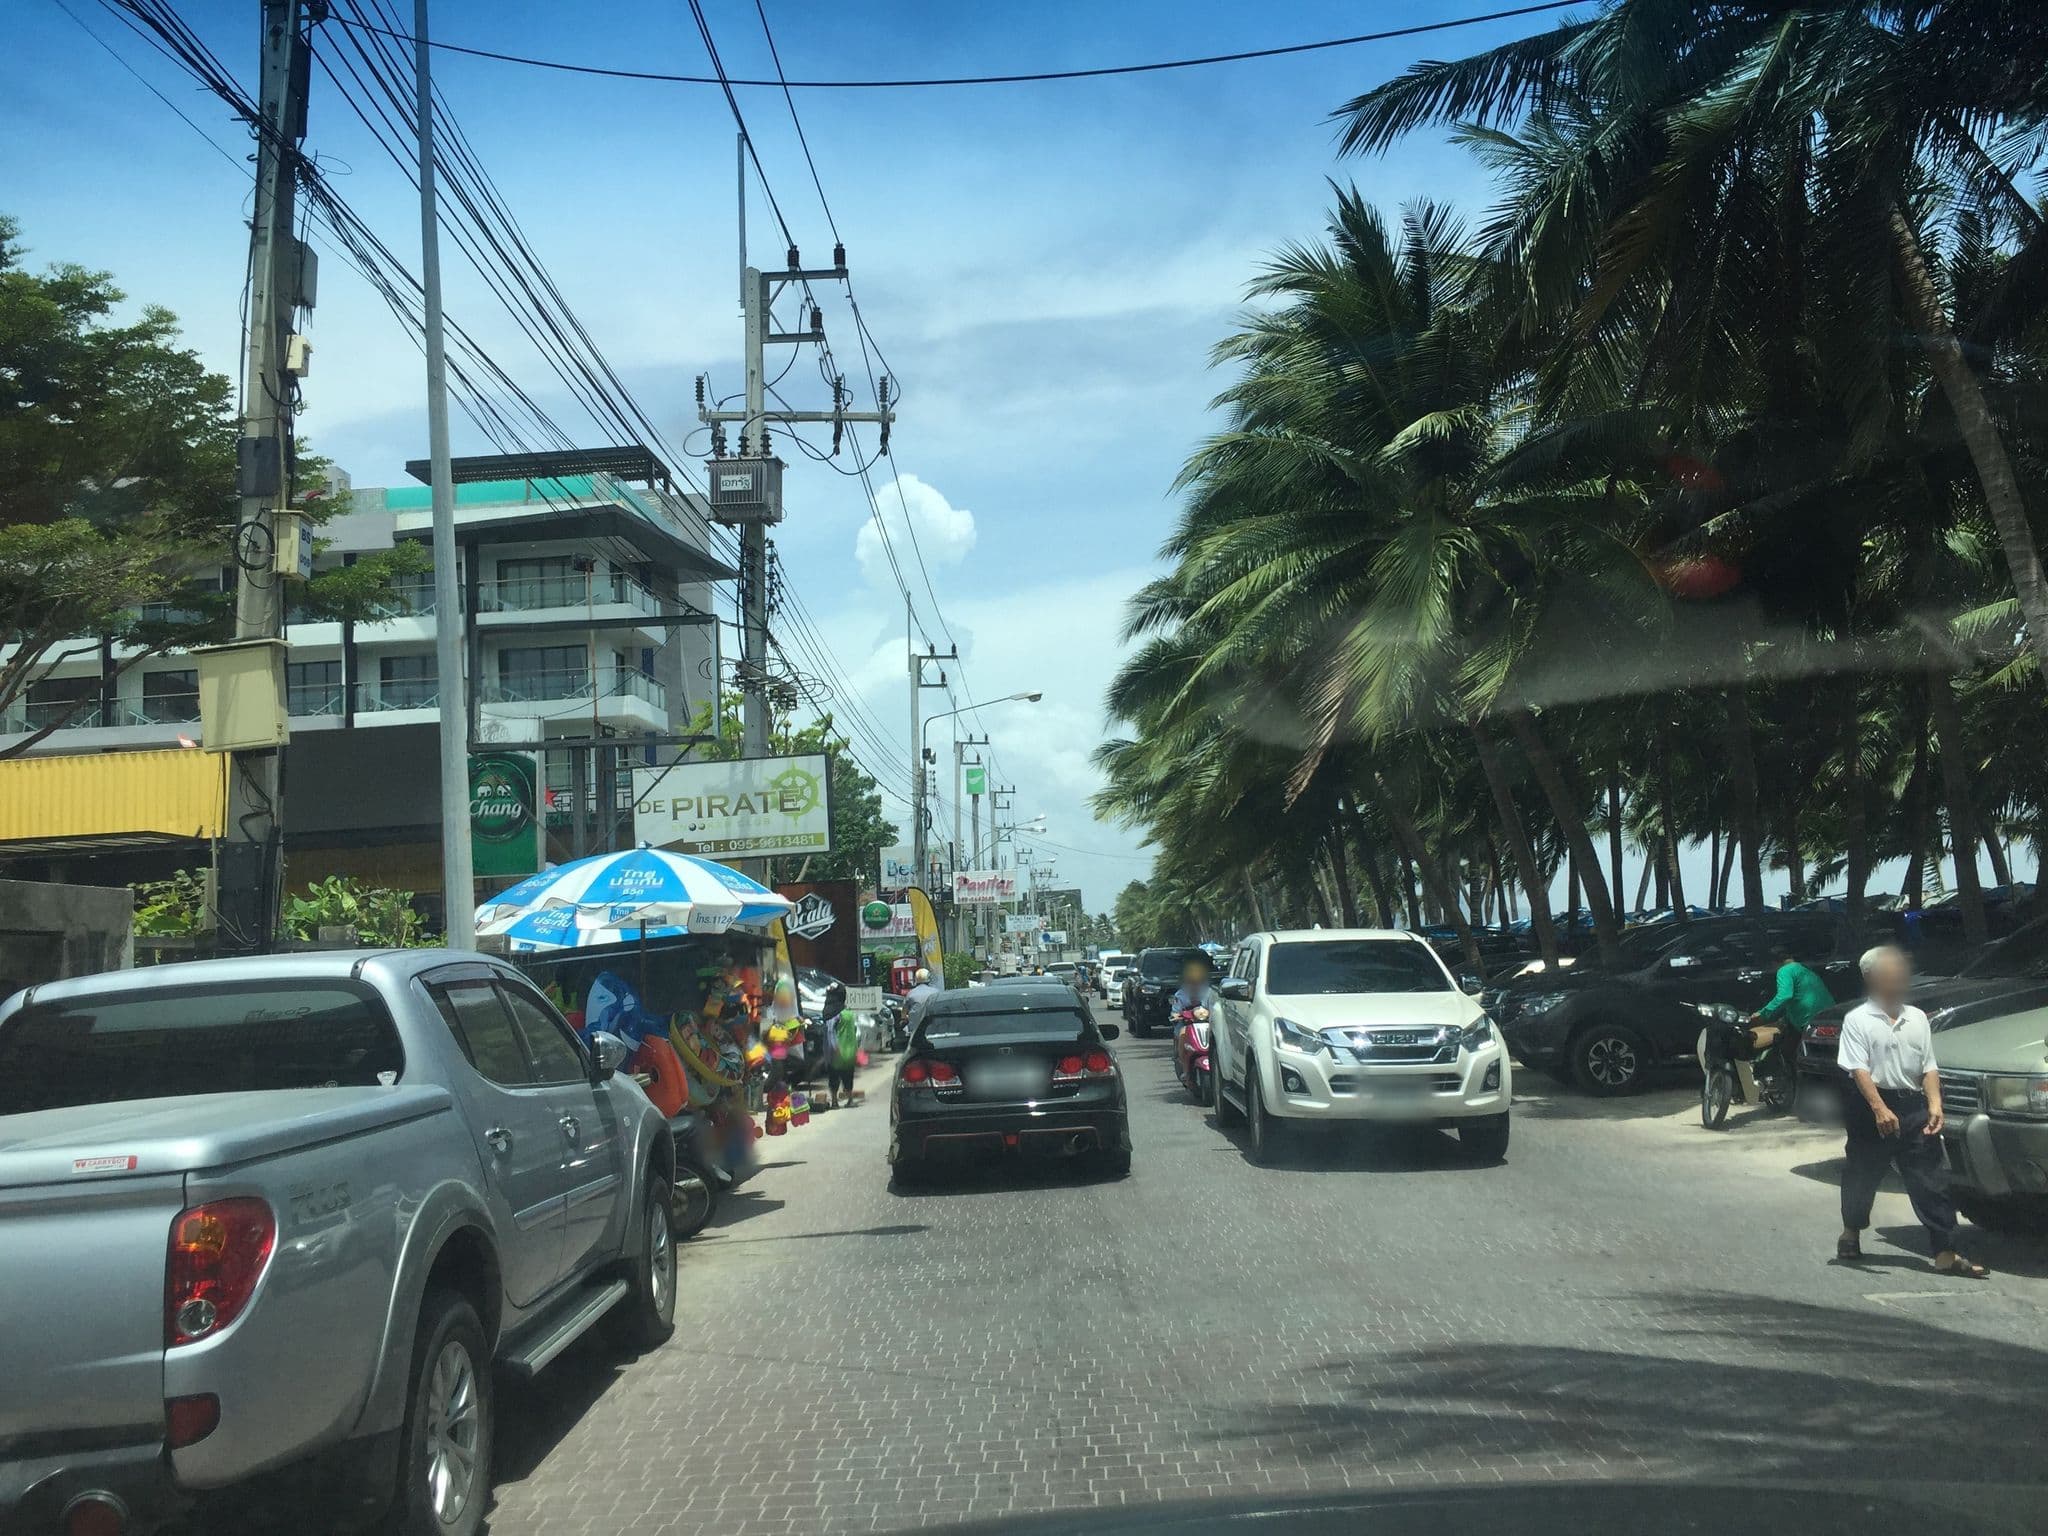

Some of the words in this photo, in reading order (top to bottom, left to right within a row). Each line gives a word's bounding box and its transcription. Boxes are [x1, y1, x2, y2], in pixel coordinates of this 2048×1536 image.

[469, 800, 522, 818] Chang
[638, 800, 666, 815] DE
[672, 789, 801, 821] PIRATE
[695, 841, 714, 854] Tel
[786, 900, 835, 930] Scala
[1372, 1034, 1416, 1044] ISUZU
